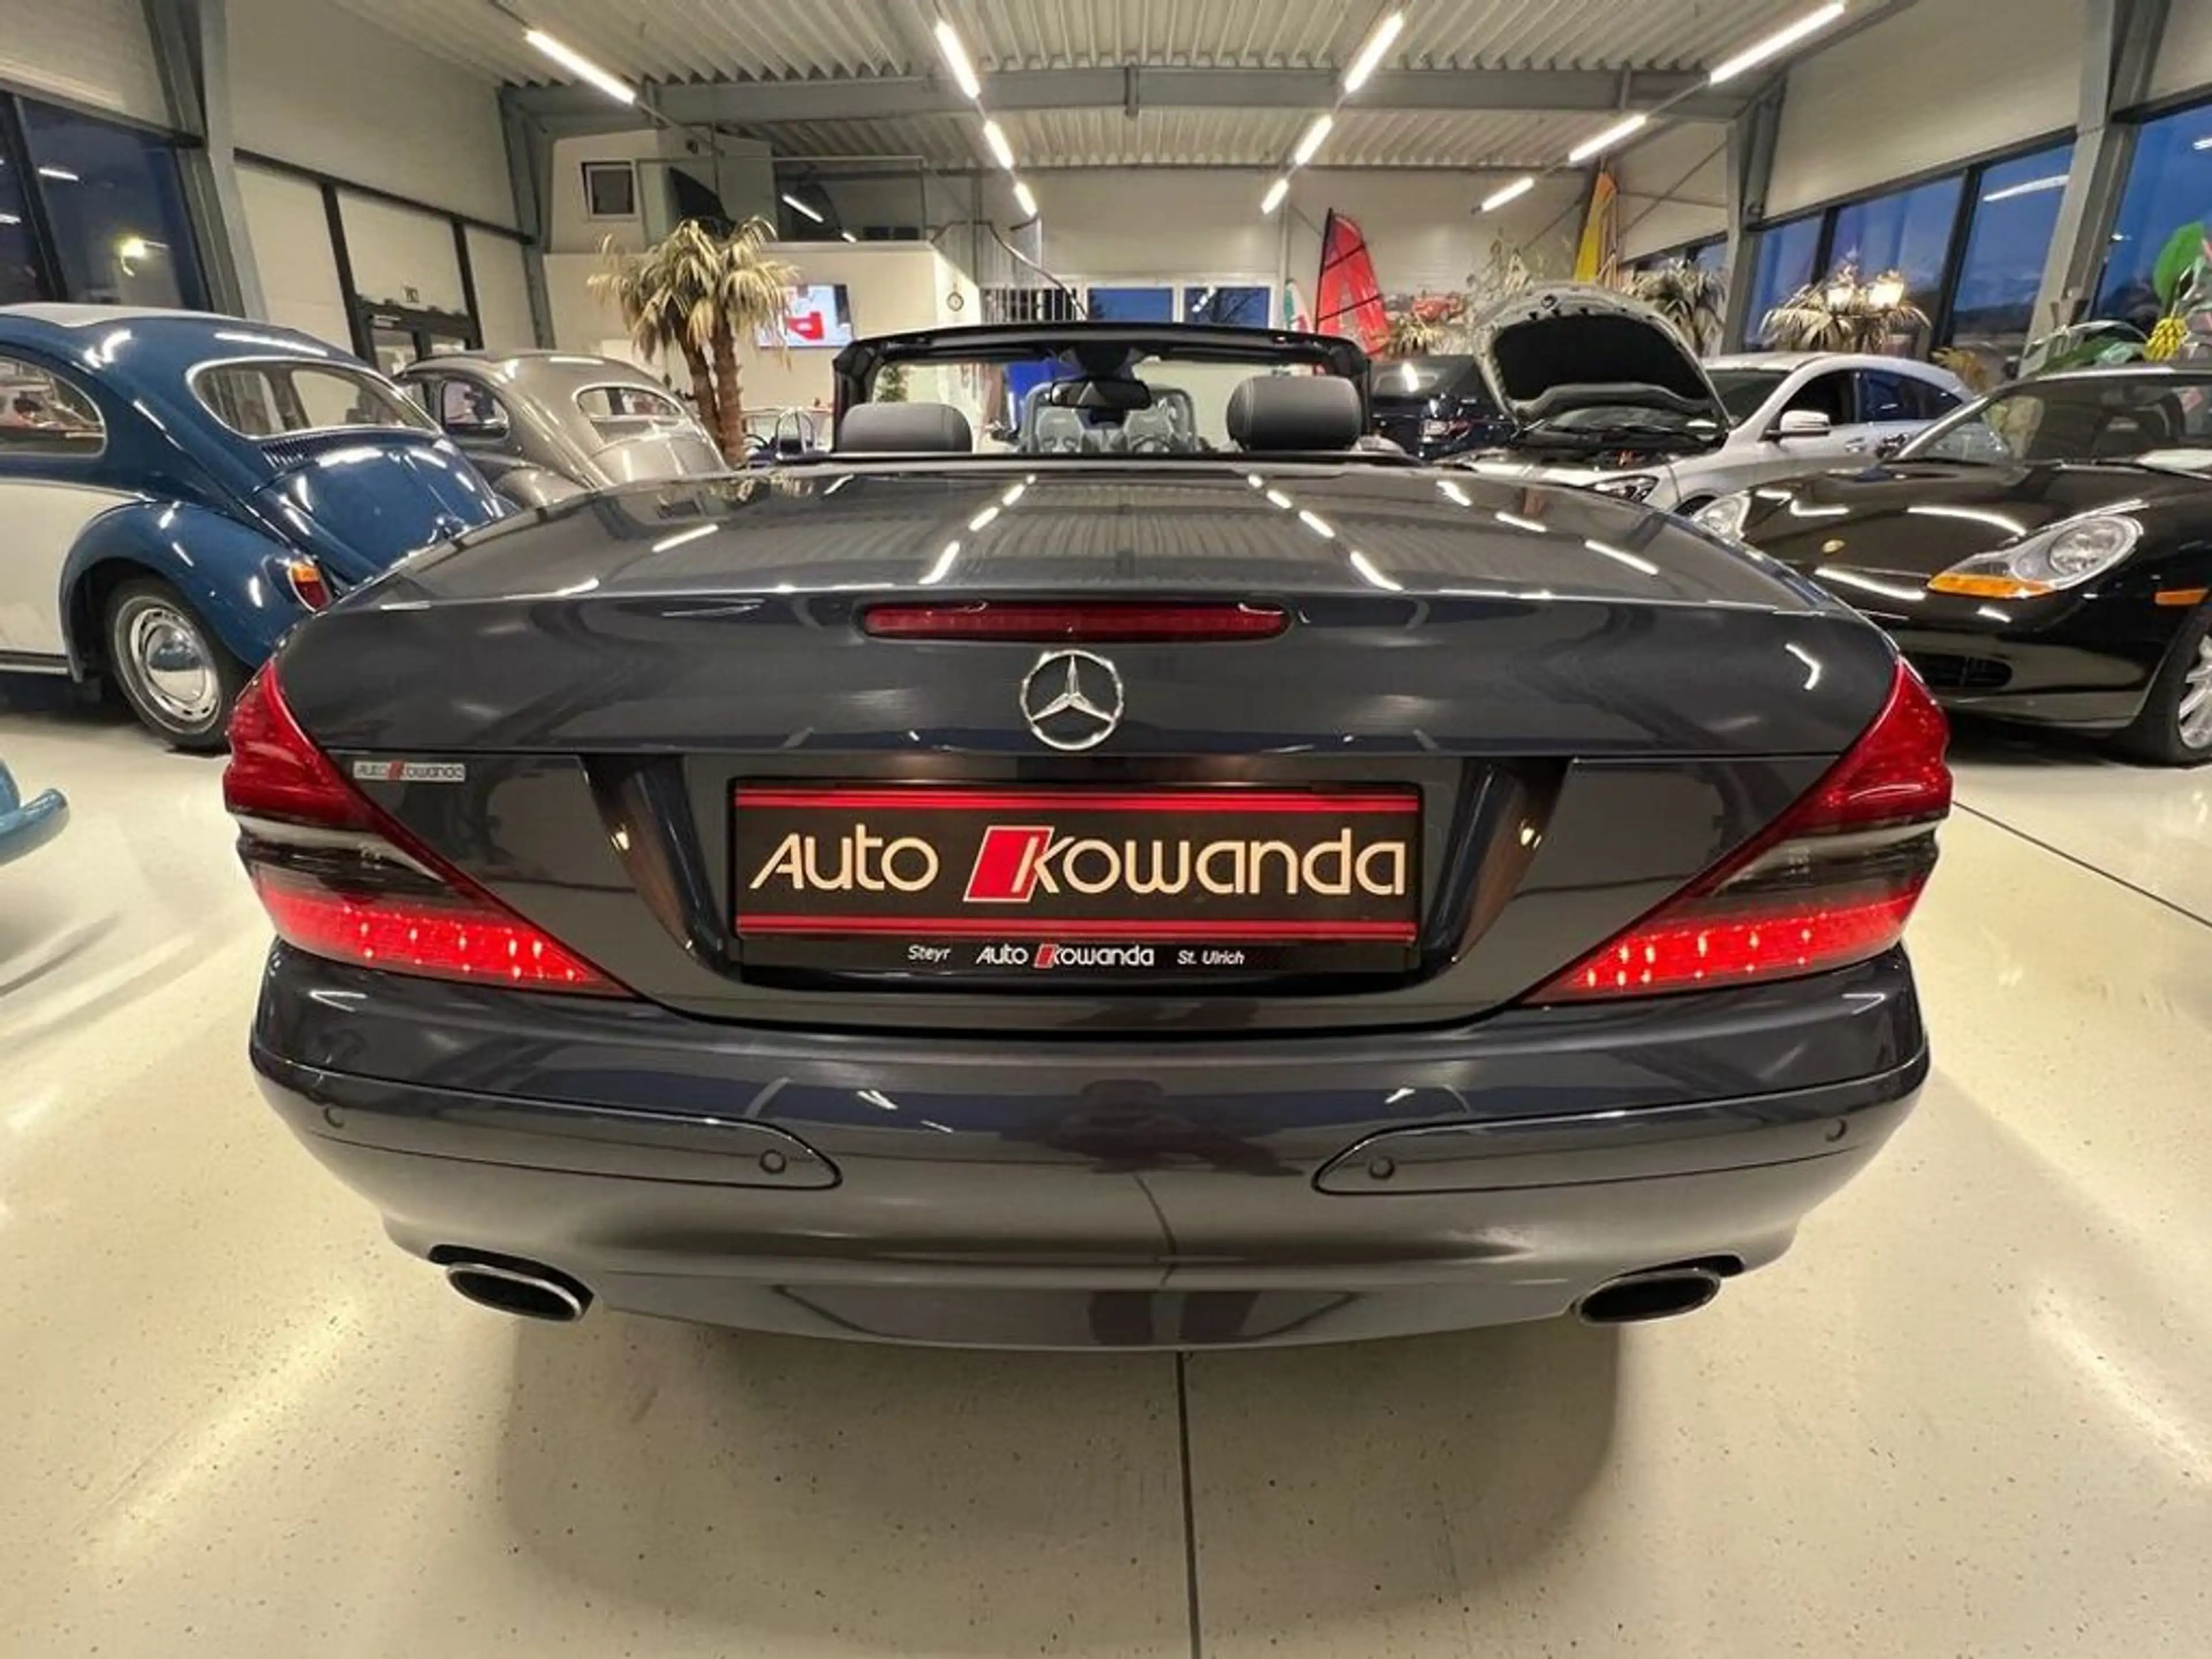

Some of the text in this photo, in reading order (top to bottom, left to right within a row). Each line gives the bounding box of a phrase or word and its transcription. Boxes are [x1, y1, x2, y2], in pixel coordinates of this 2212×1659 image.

[749, 824, 1404, 895] Auto Kowanda
[907, 944, 1245, 965] Steyr Auto Kowanda St. Ulrich
